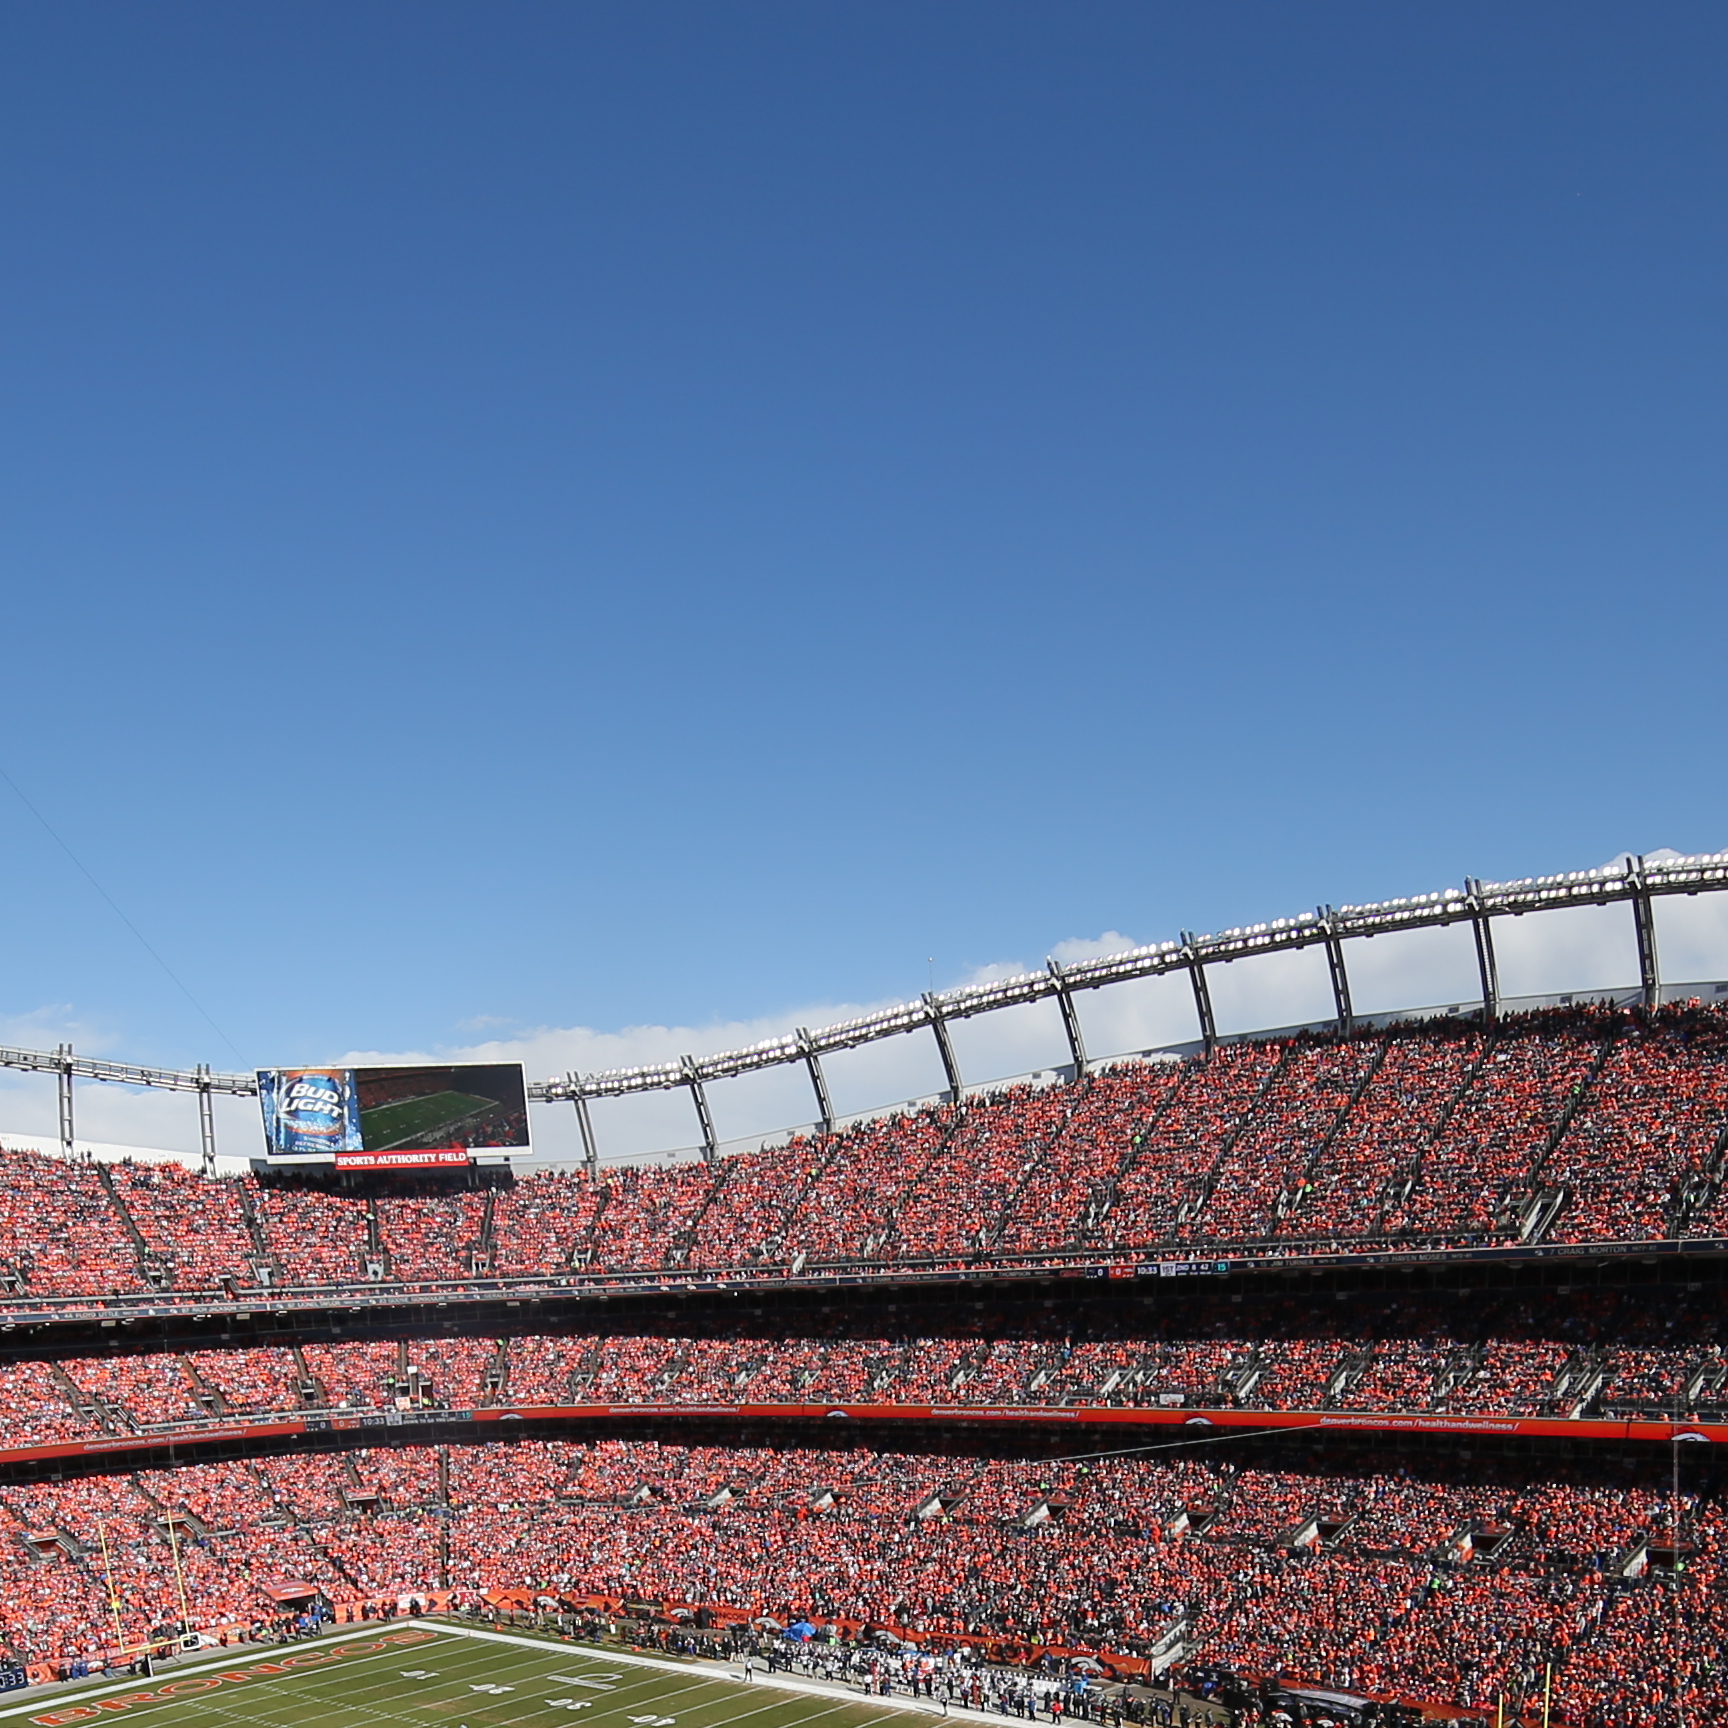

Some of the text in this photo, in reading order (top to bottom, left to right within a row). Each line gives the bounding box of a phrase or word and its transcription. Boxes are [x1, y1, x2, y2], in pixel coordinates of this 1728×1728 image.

[290, 1083, 339, 1103] BUD
[281, 1098, 343, 1118] LIGHT
[337, 1152, 467, 1166] SPORTS AUTHORITY FIELD
[1419, 1253, 1447, 1261] MOSES
[1557, 1247, 1585, 1255] CRAIG
[1588, 1245, 1627, 1254] MORTON
[363, 1417, 385, 1426] 10:33
[1319, 1416, 1520, 1432] denverbroncos.com/healthandwellness/
[29, 1630, 439, 1728] BRONCOS
[632, 1714, 676, 1728] 40
